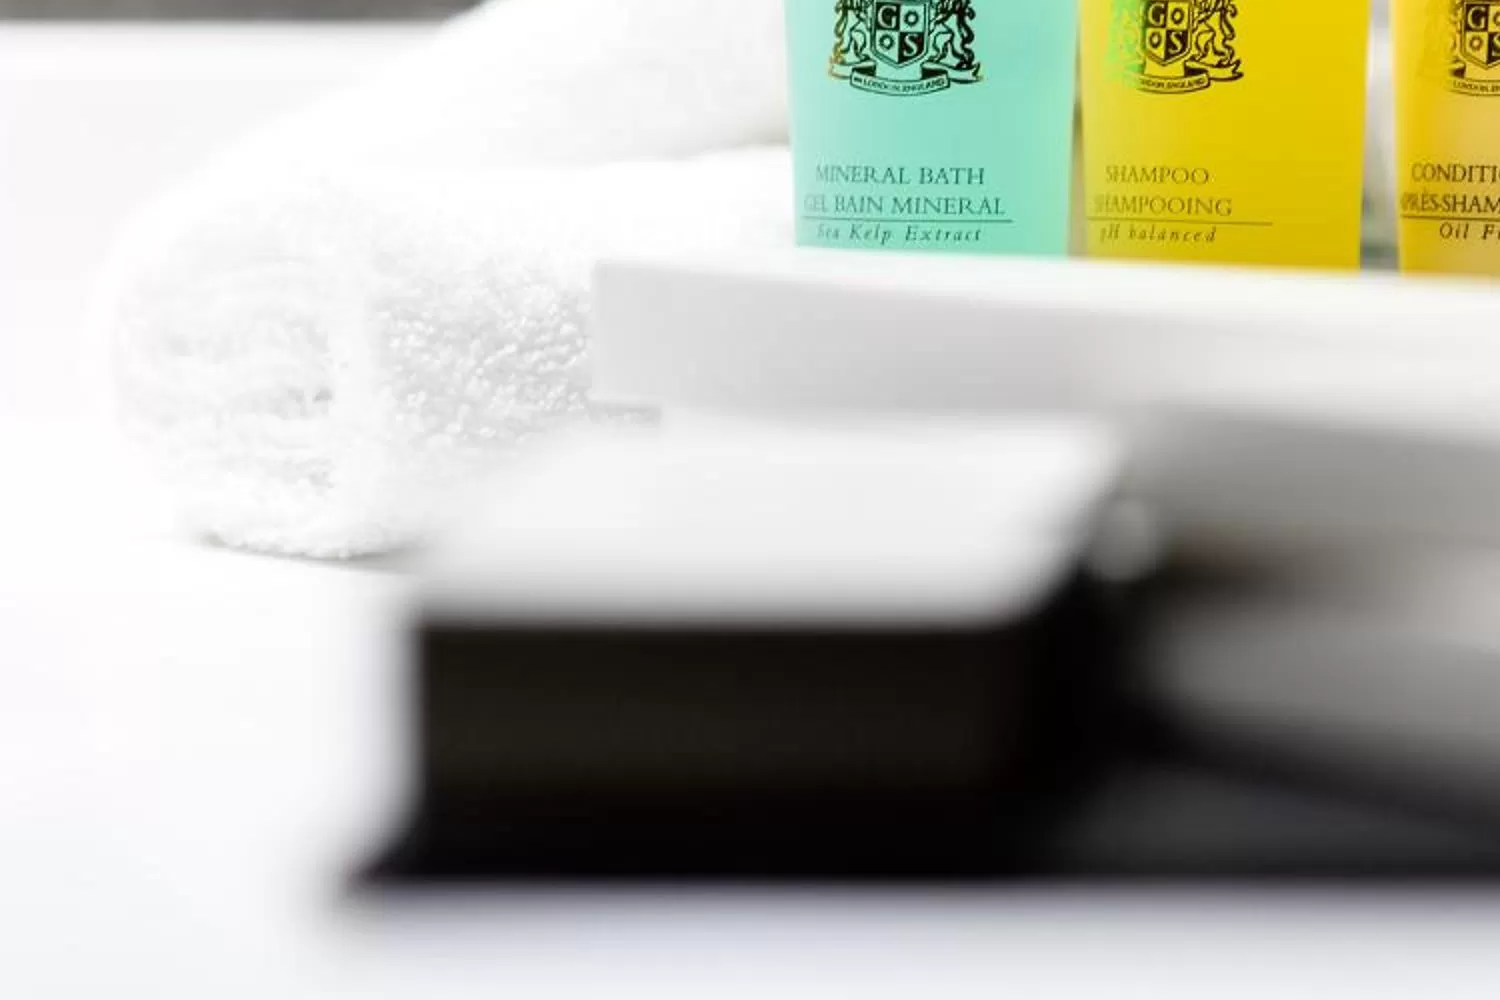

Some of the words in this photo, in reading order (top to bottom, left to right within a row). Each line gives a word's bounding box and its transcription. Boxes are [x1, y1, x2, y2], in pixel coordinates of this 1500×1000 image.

[877, 5, 897, 29] G
[1149, 3, 1166, 26] G
[1467, 6, 1486, 31] G
[903, 33, 920, 57] S
[1169, 31, 1186, 54] S
[816, 165, 911, 185] MINERAL
[919, 167, 985, 186] BATH
[1105, 165, 1210, 185] SHAMPOO
[835, 194, 884, 214] BAIN
[891, 196, 1006, 217] MINERAL
[849, 223, 892, 245] Kelp
[905, 224, 982, 243] Extract
[1129, 224, 1218, 243] balanced
[1440, 221, 1469, 240] Oil
